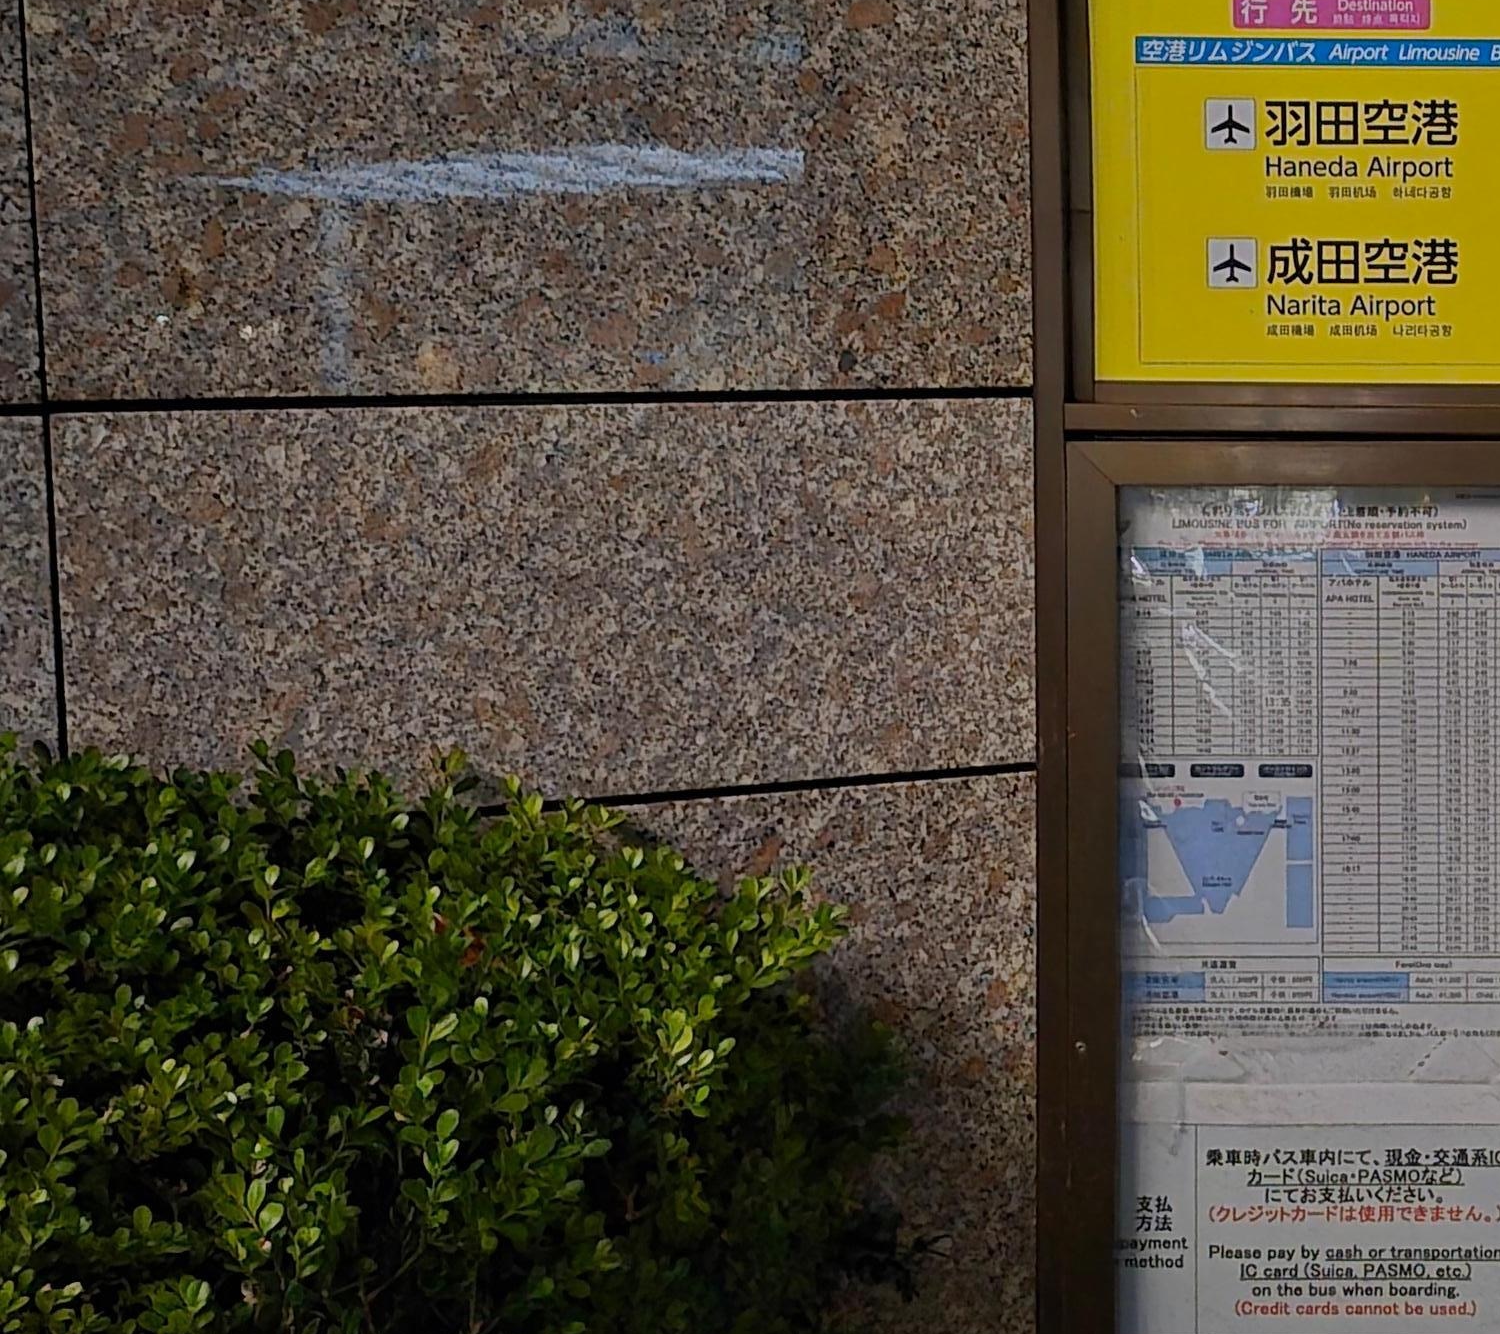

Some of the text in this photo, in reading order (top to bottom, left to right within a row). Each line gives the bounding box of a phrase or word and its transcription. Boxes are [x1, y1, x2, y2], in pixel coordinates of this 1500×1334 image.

[1140, 40, 1317, 63] 空港リムジンバス
[1328, 42, 1388, 64] Airport
[1398, 43, 1480, 62] Limousine
[1265, 99, 1458, 146] 羽田空港
[1265, 156, 1453, 183] Haneda Airport
[1267, 238, 1458, 285] 成田空港
[1267, 294, 1436, 322] Narita Airport
[1365, 519, 1423, 529] reservation
[1136, 1195, 1173, 1213] 支払
[1265, 1186, 1443, 1204] にてお支払いください。
[1136, 1215, 1173, 1232] 方法
[1124, 1254, 1184, 1269] method
[1208, 1244, 1262, 1259] Please
[1267, 1248, 1295, 1261] pay
[1301, 1244, 1320, 1261] by
[1325, 1244, 1362, 1259] cash
[1368, 1248, 1386, 1259] or
[1240, 1262, 1472, 1280] IC card (Suica, PASMO, etc.)
[1252, 1282, 1460, 1299] on the bus when boarding.
[1234, 1300, 1476, 1317] (Credit cards cannot be used.)
